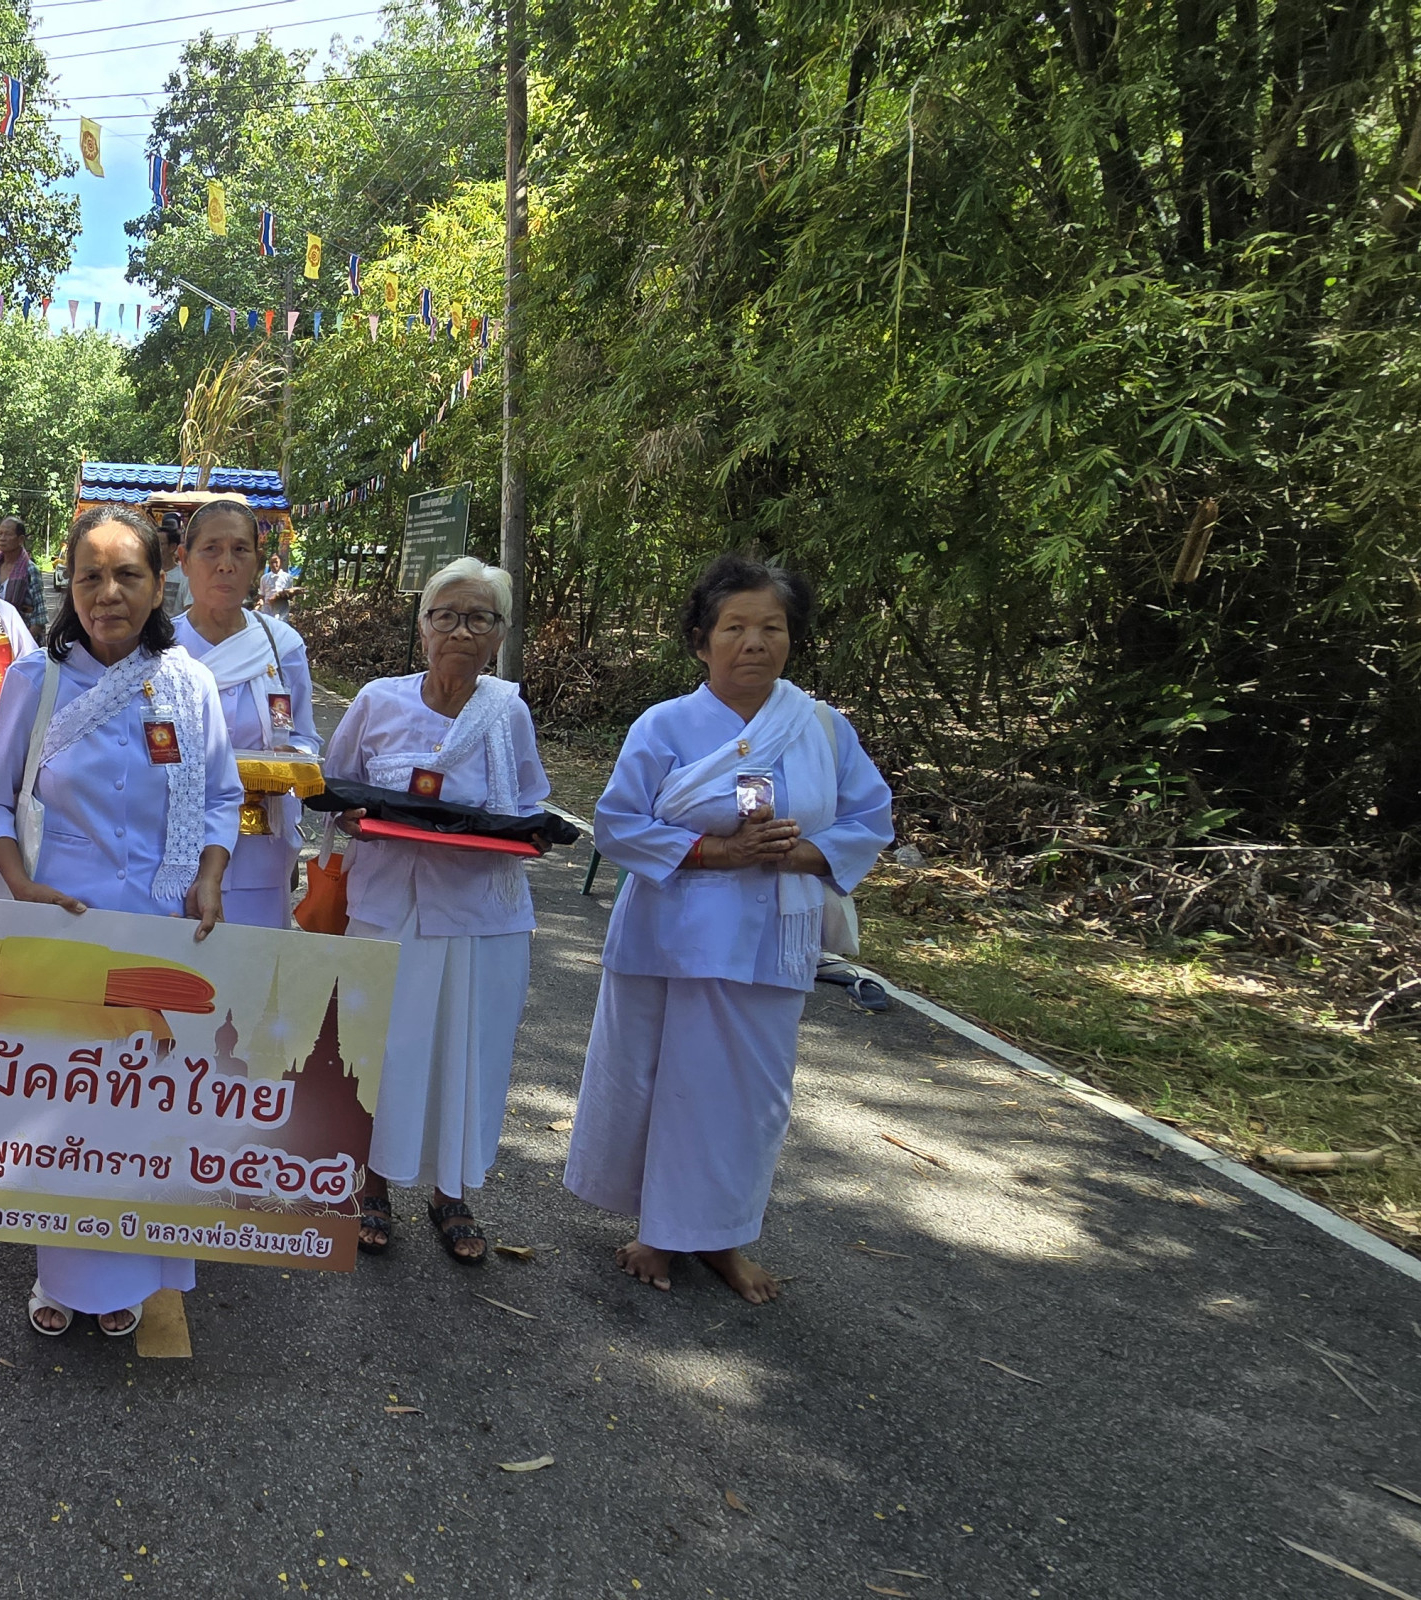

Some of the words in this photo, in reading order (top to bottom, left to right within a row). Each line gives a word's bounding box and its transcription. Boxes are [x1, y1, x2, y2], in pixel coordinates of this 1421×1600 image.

[189, 1146, 348, 1197] ๒๕๖๘
[77, 1217, 111, 1237] ๘๑
[121, 1214, 136, 1237] ปี
[146, 1224, 330, 1255] หลวงพ่อธัมมชโย
